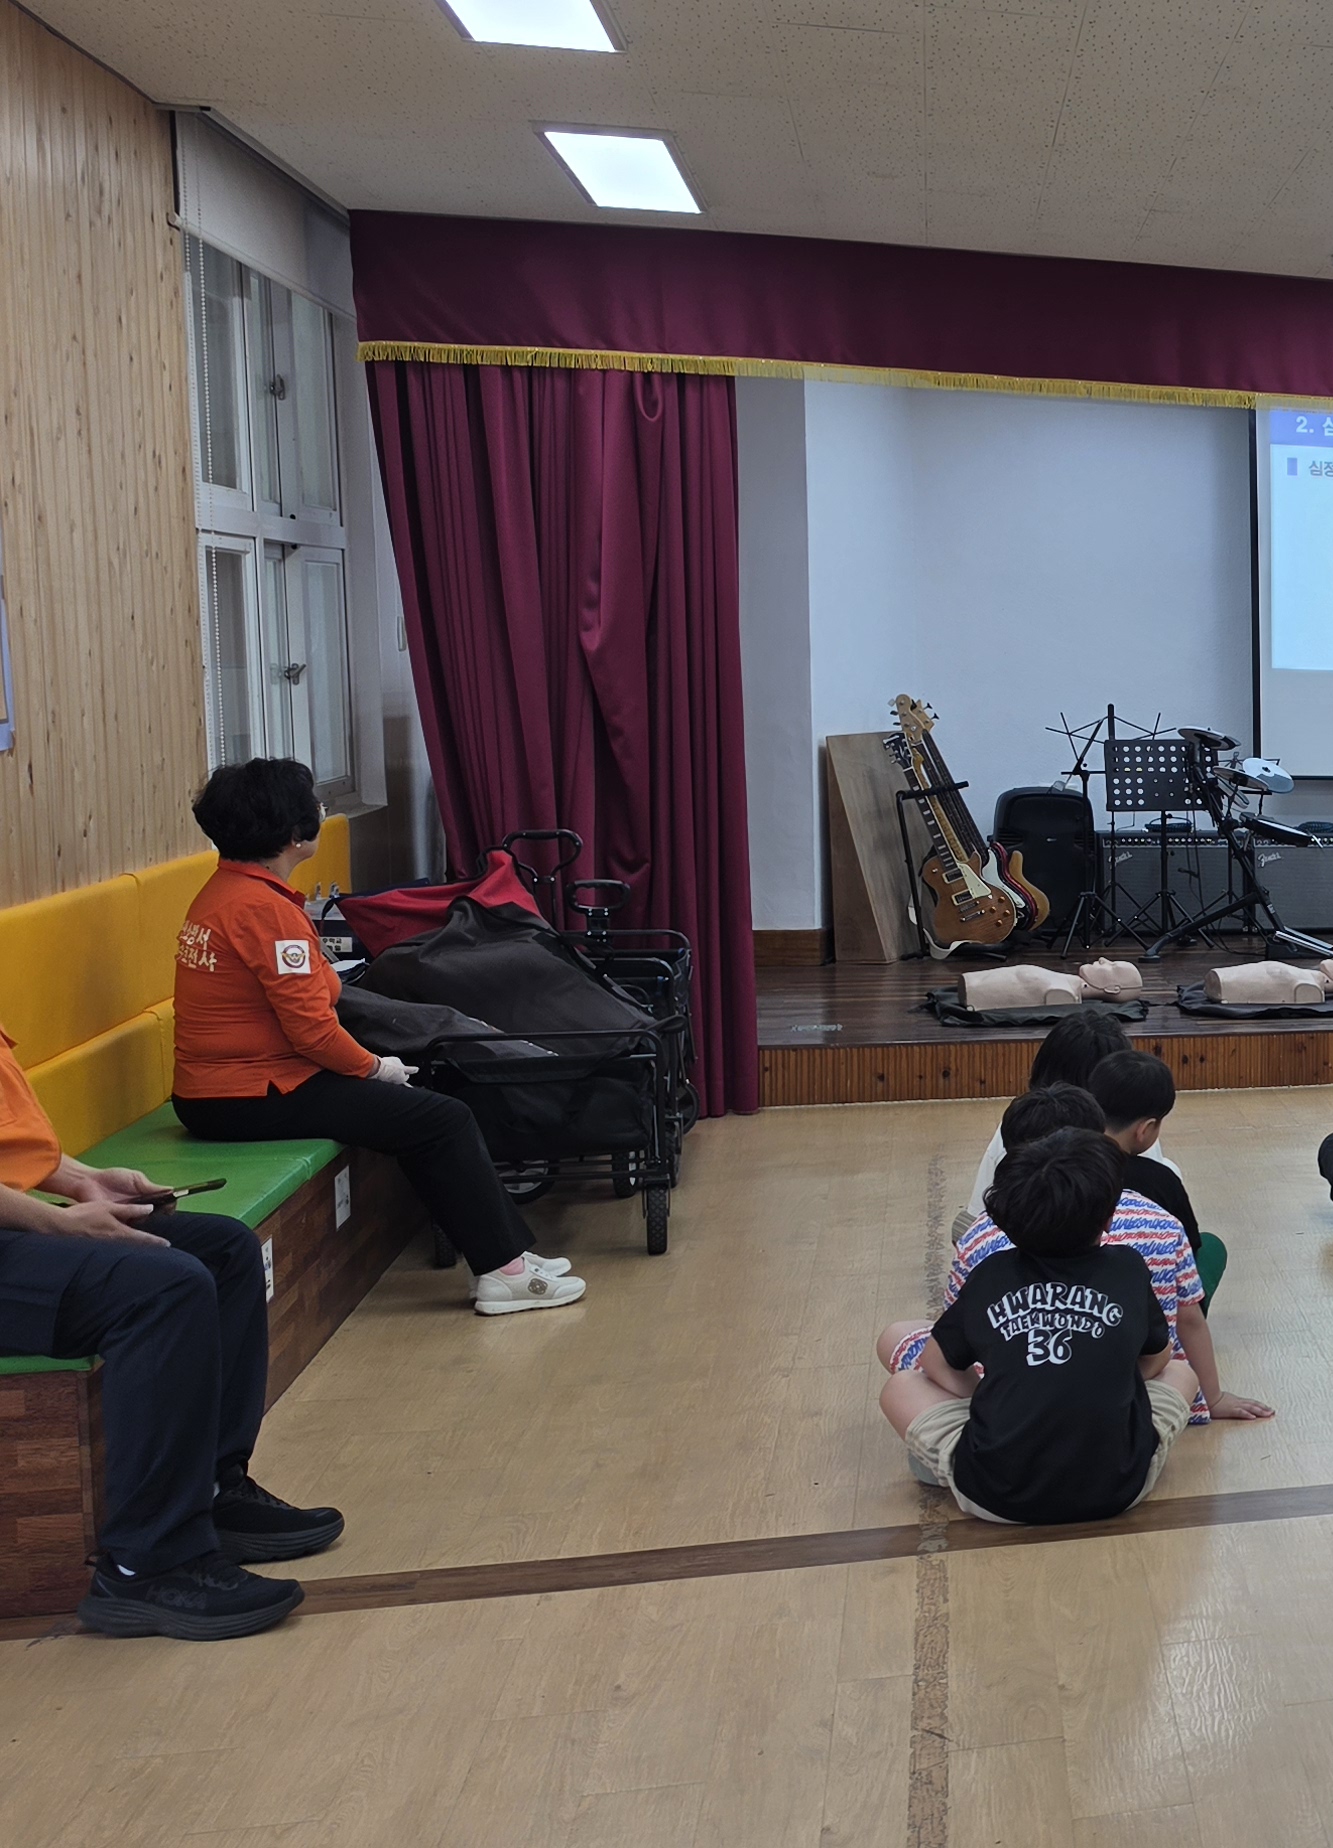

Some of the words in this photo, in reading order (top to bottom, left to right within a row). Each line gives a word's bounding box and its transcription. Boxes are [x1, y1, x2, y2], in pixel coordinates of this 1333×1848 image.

[1296, 416, 1314, 433] 2.
[987, 1281, 1123, 1328] HWARANG
[1000, 1311, 1105, 1341] TAEKWONDO
[1026, 1327, 1072, 1366] 36
